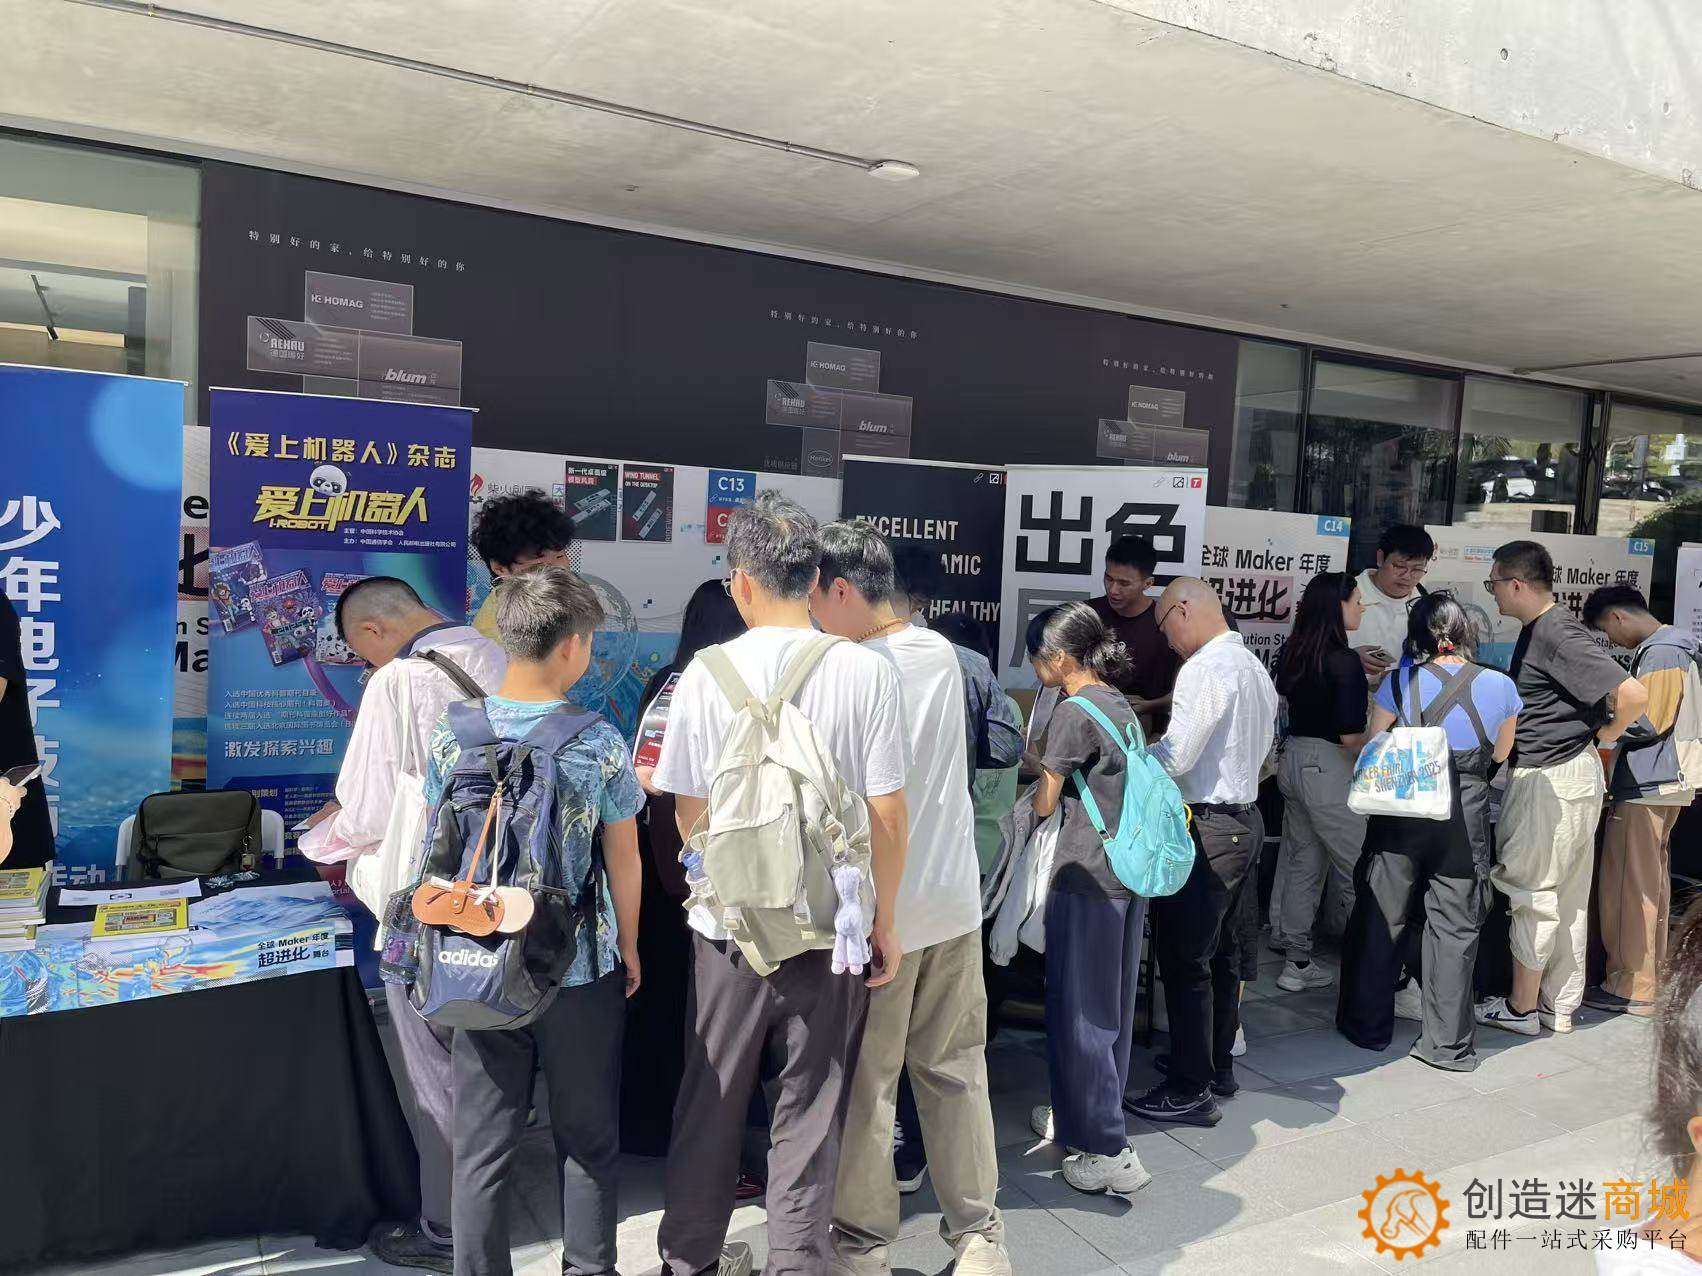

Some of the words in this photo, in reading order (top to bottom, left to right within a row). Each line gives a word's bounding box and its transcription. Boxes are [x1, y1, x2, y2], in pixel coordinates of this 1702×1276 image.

[324, 295, 363, 309] HOMAG
[385, 368, 427, 385] blum
[858, 420, 888, 434] blum
[1167, 451, 1190, 463] blum
[718, 476, 745, 492] C13
[1324, 519, 1343, 532] C14
[1634, 541, 1648, 552] C15
[1235, 549, 1294, 571] Maker
[1299, 553, 1332, 574] 年度
[1567, 567, 1611, 585] Maker
[224, 739, 334, 758] 激发探索兴趣
[1418, 760, 1441, 779] 2025
[257, 940, 275, 950] 全球
[278, 936, 310, 948] Maker
[312, 932, 329, 941] 年度
[257, 946, 311, 968] 超进化
[438, 948, 499, 968] adidas
